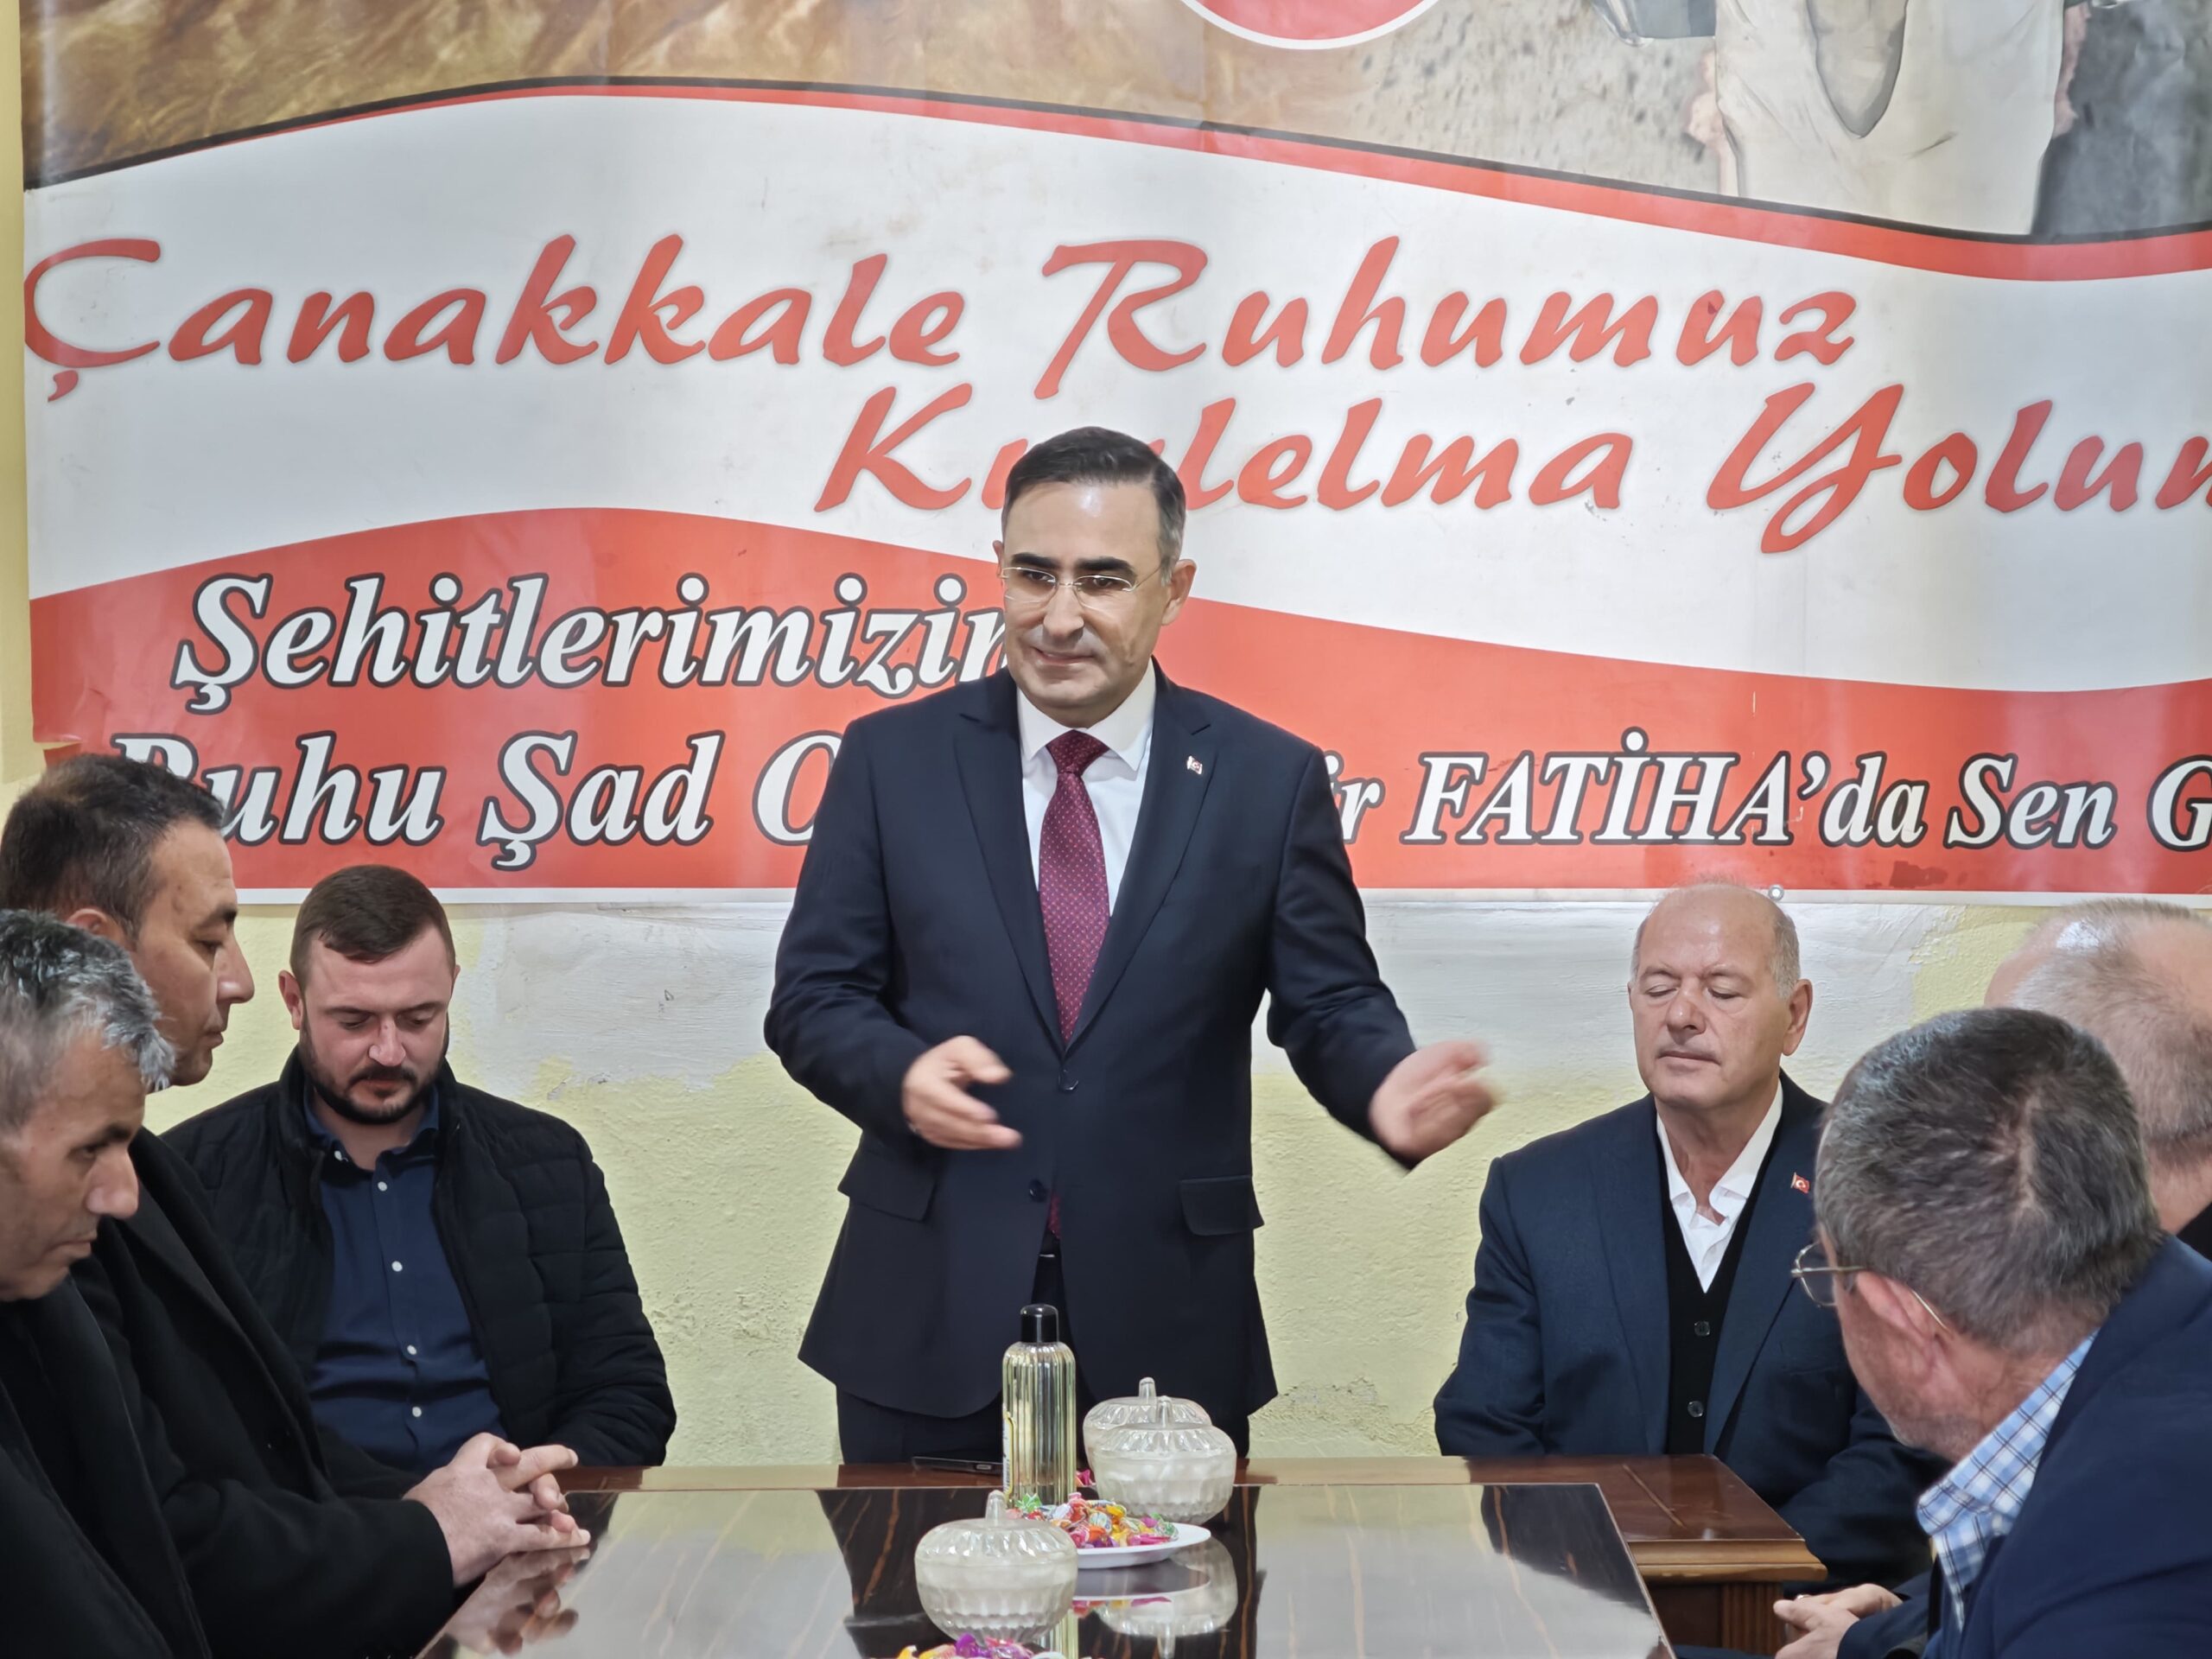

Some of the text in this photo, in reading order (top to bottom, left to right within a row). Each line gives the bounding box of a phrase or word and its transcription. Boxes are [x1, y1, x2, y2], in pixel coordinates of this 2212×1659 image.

[23, 233, 1857, 403] Çanakkale Ruhumuz
[476, 730, 725, 869] Şad
[1399, 727, 1924, 847] FATİHA'da
[1943, 753, 2119, 850] Sen
